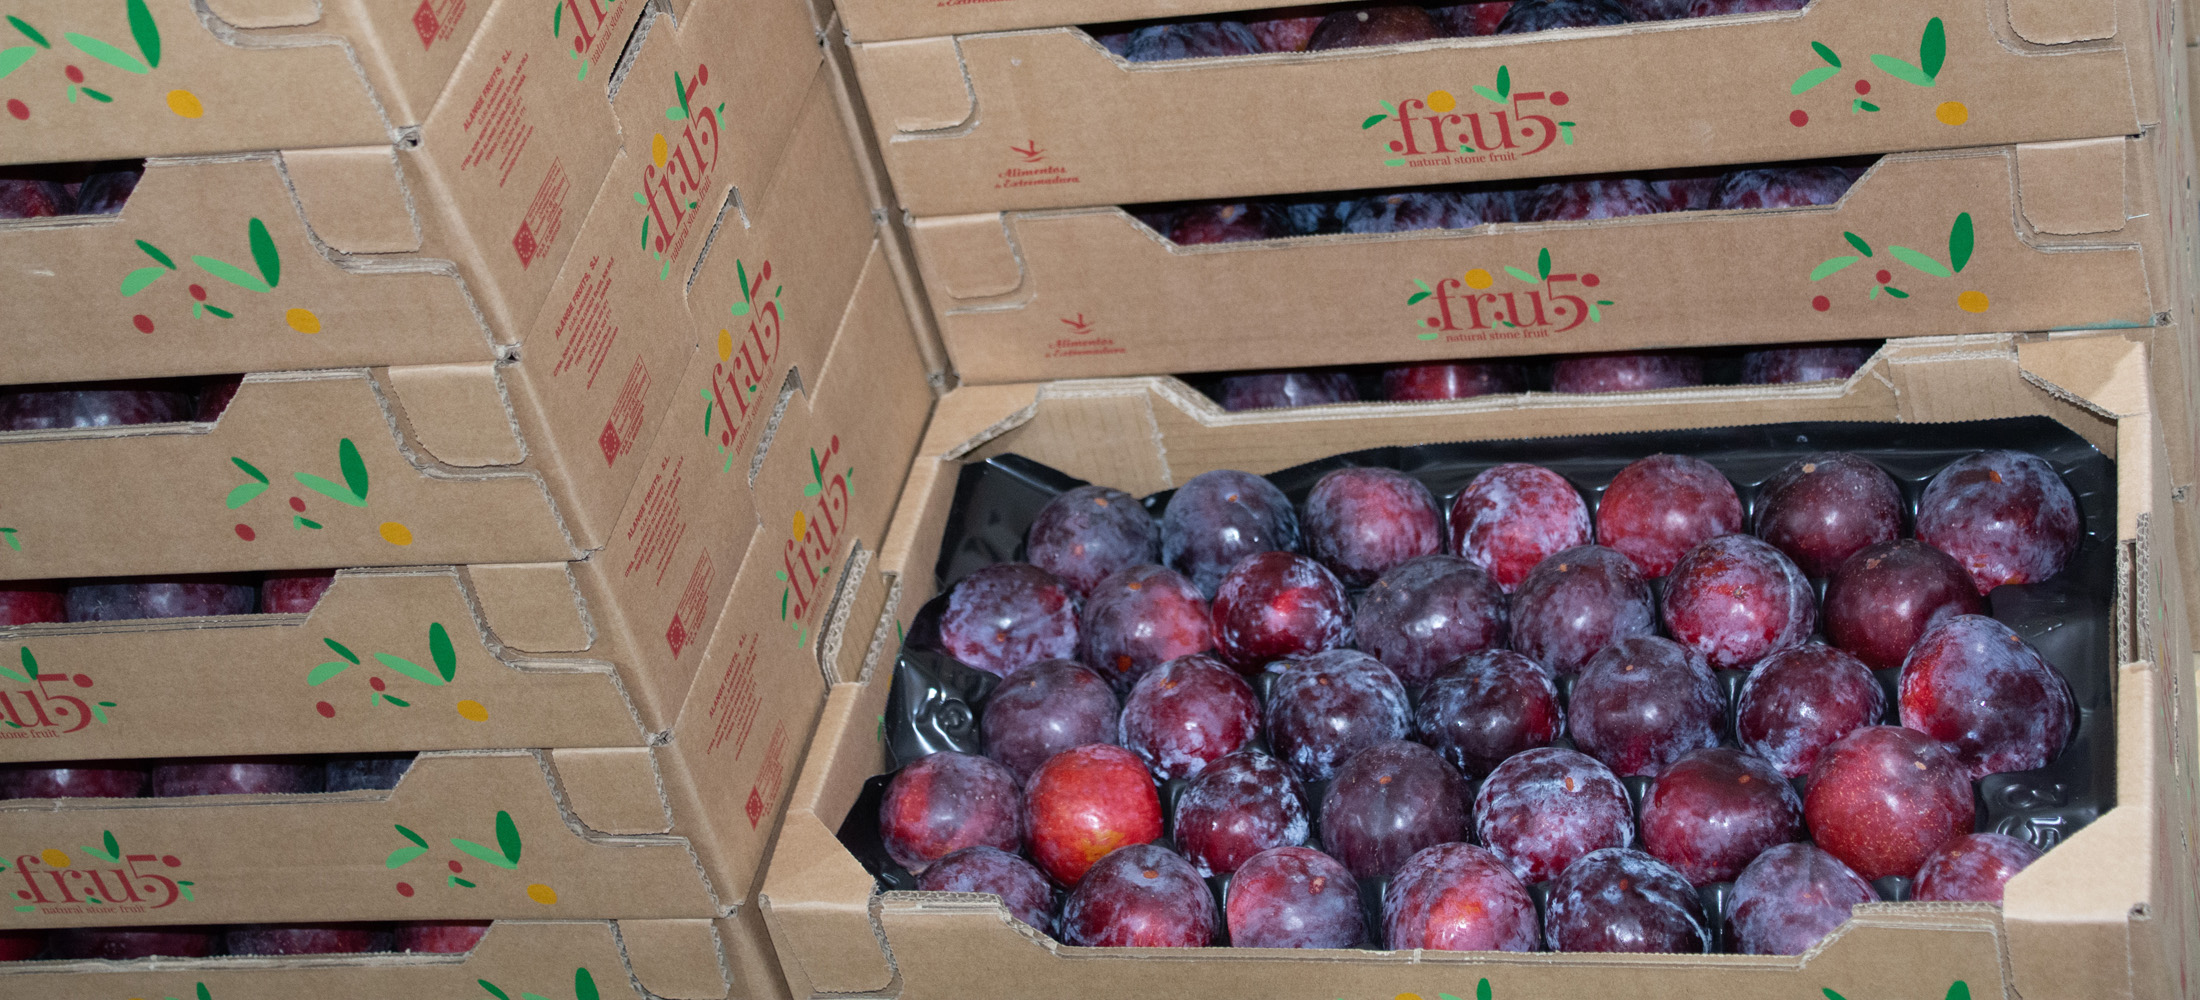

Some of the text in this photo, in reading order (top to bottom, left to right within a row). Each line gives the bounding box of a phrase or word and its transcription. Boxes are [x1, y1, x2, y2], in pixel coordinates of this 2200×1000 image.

[591, 3, 624, 66] natural stone
[464, 96, 484, 131] ALANGE
[1391, 91, 1569, 156] fru5
[644, 64, 718, 254] fru5
[997, 166, 1066, 178] Alimentos
[1409, 152, 1517, 168] natural stone fruit
[671, 175, 711, 263] natural stone fruit
[555, 303, 574, 338] ALANGE
[572, 272, 591, 304] FRUITS,
[1429, 273, 1600, 333] fru5
[712, 260, 780, 447] fru5
[1446, 328, 1549, 343] natural stone fruit
[736, 415, 752, 455] natural
[762, 366, 773, 390] fruit
[627, 504, 645, 539] ALANGE
[644, 474, 662, 505] FRUITS,
[784, 435, 848, 620] fru5
[0, 673, 93, 734] u5
[0, 729, 60, 739] tone fruit
[14, 854, 182, 909] fru5
[42, 904, 145, 915] natural stone fruit
